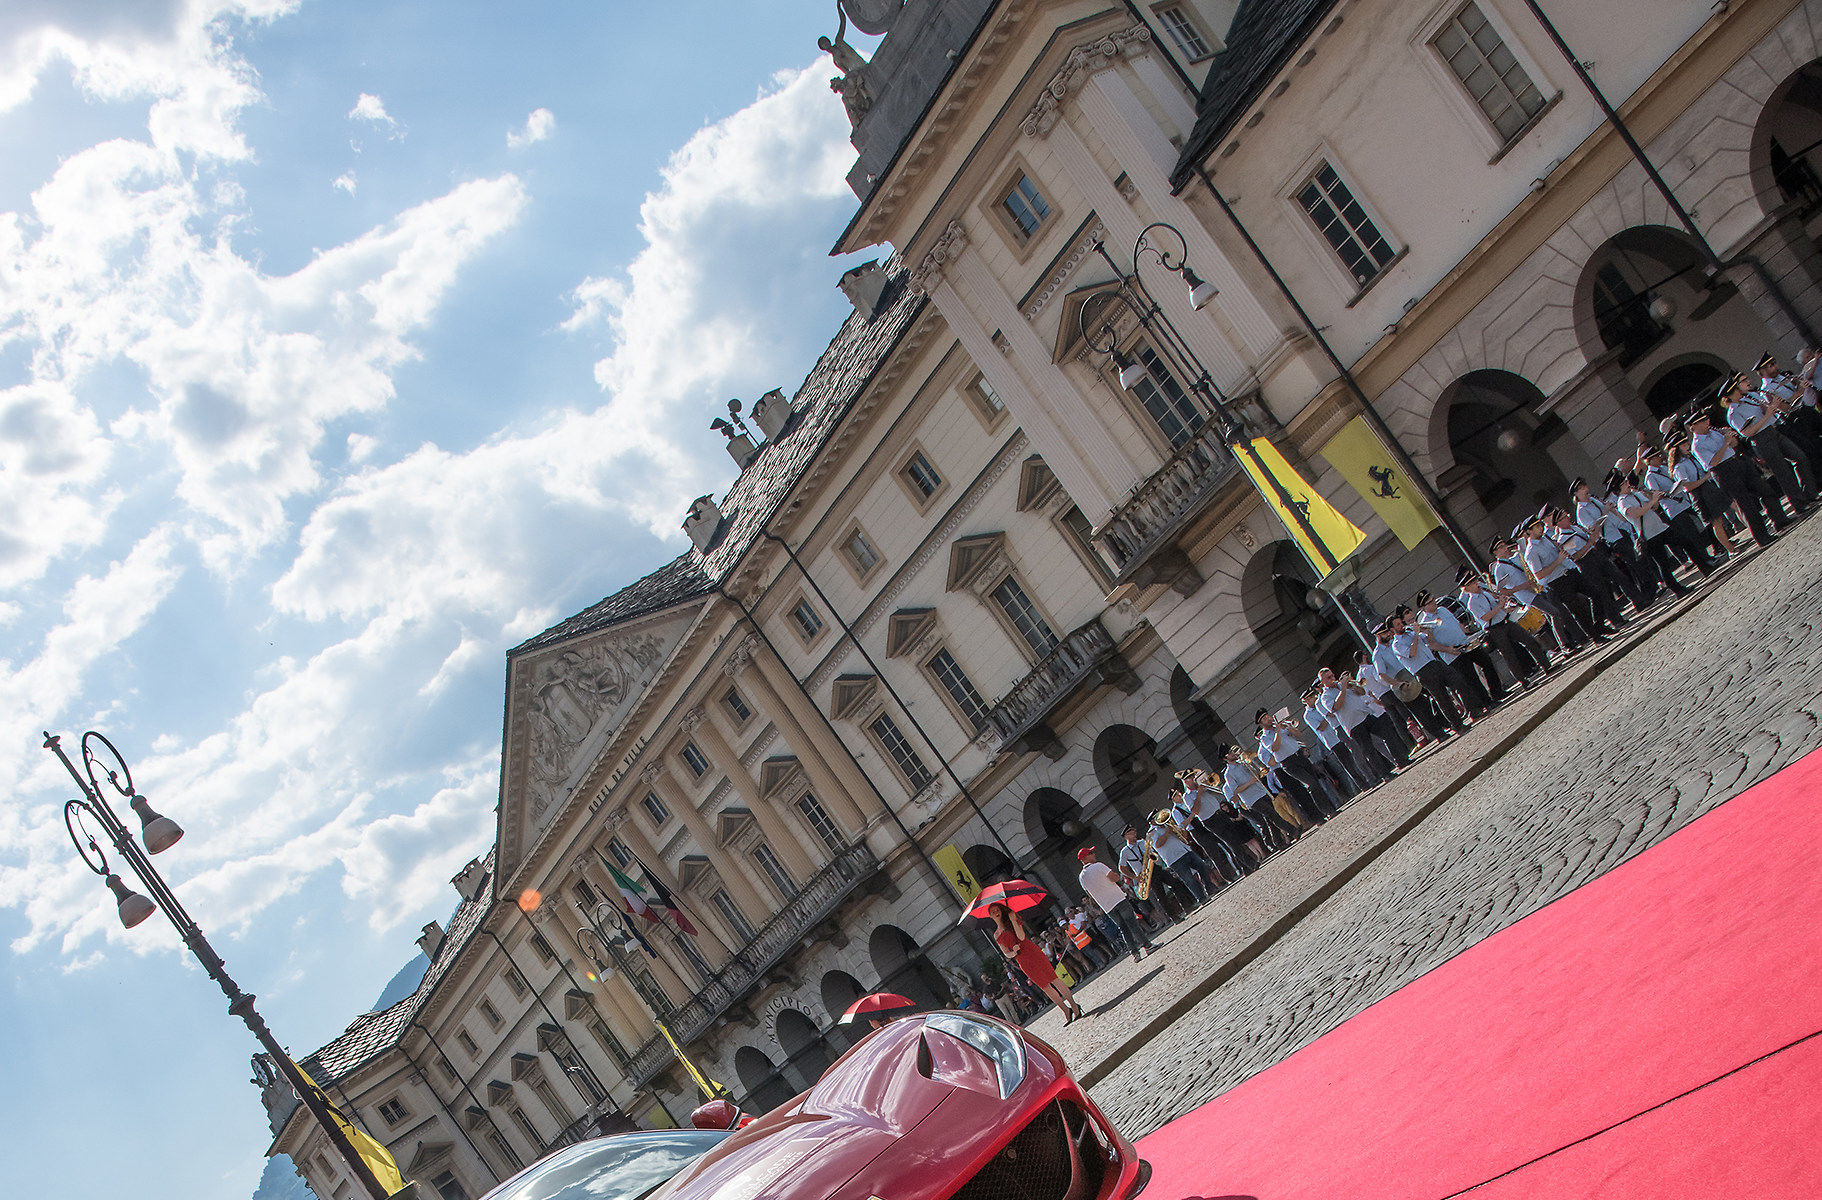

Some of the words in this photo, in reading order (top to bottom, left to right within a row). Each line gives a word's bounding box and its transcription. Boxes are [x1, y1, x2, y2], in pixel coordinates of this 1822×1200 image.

[588, 784, 613, 815] HOTEL
[612, 768, 624, 783] DE
[623, 736, 648, 765] VILLE
